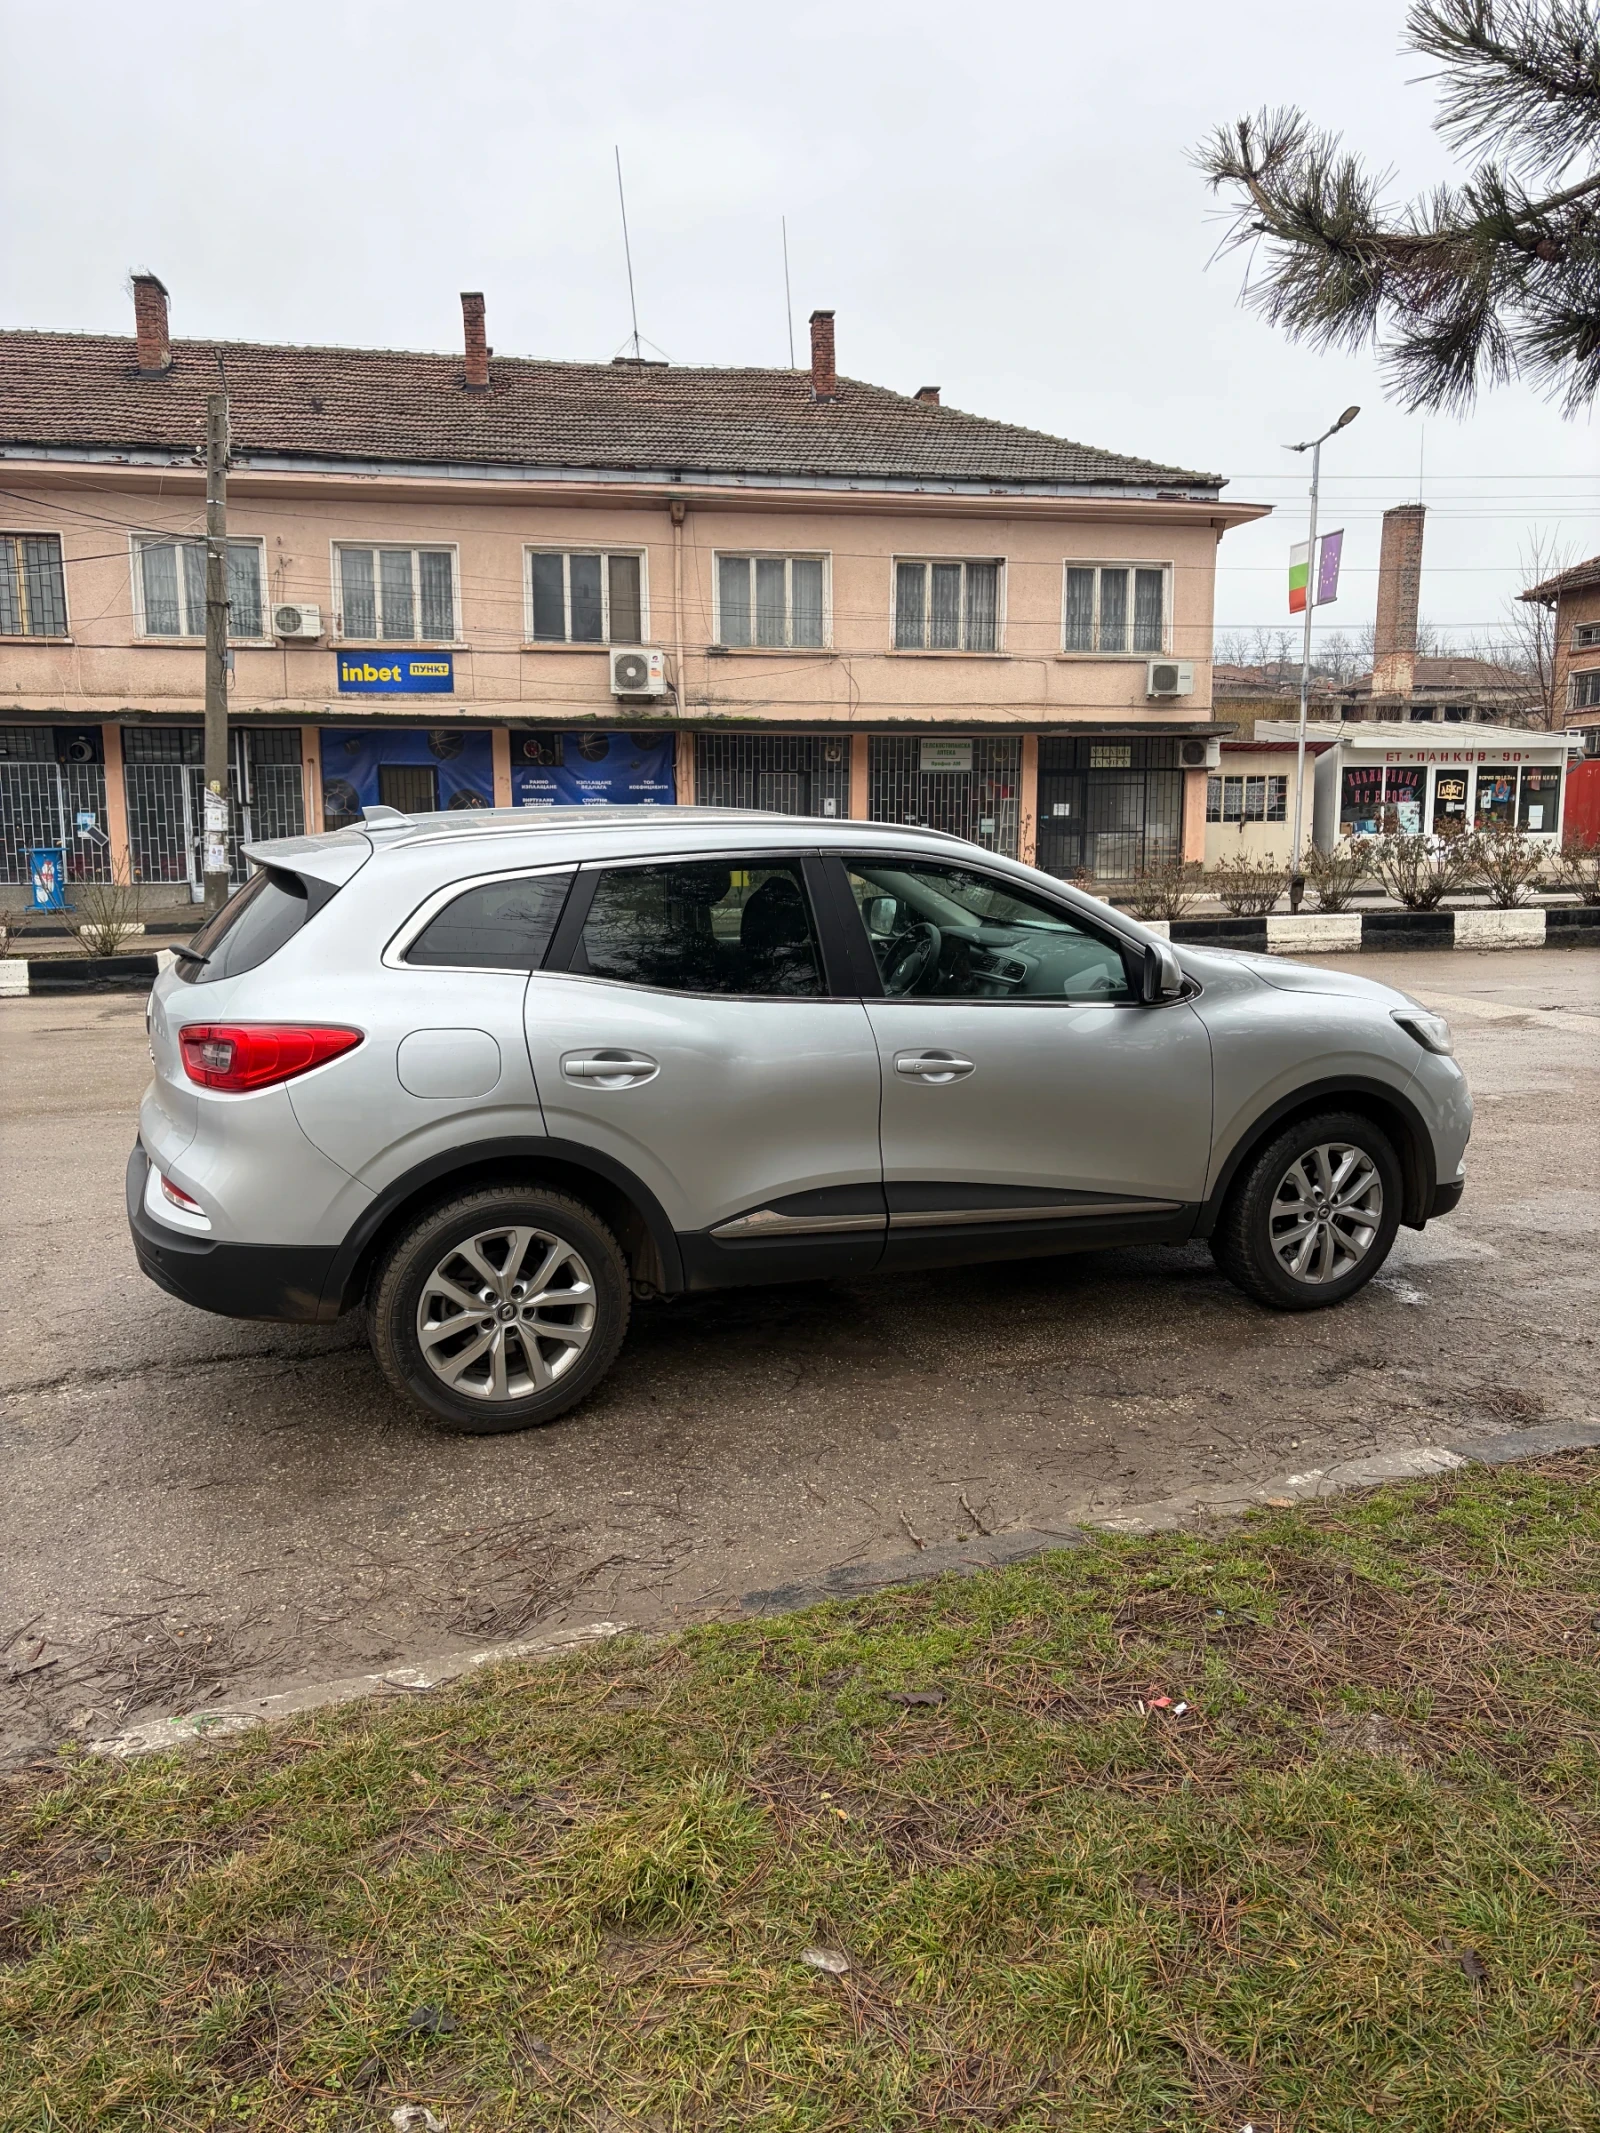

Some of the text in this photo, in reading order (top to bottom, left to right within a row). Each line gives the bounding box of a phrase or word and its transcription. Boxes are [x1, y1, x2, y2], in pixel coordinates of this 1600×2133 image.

[342, 662, 402, 682] inbet
[412, 665, 447, 673] ПУНКТ
[1386, 752, 1402, 761] ЕТ
[1348, 769, 1418, 787] КНИЖАРНИЦА
